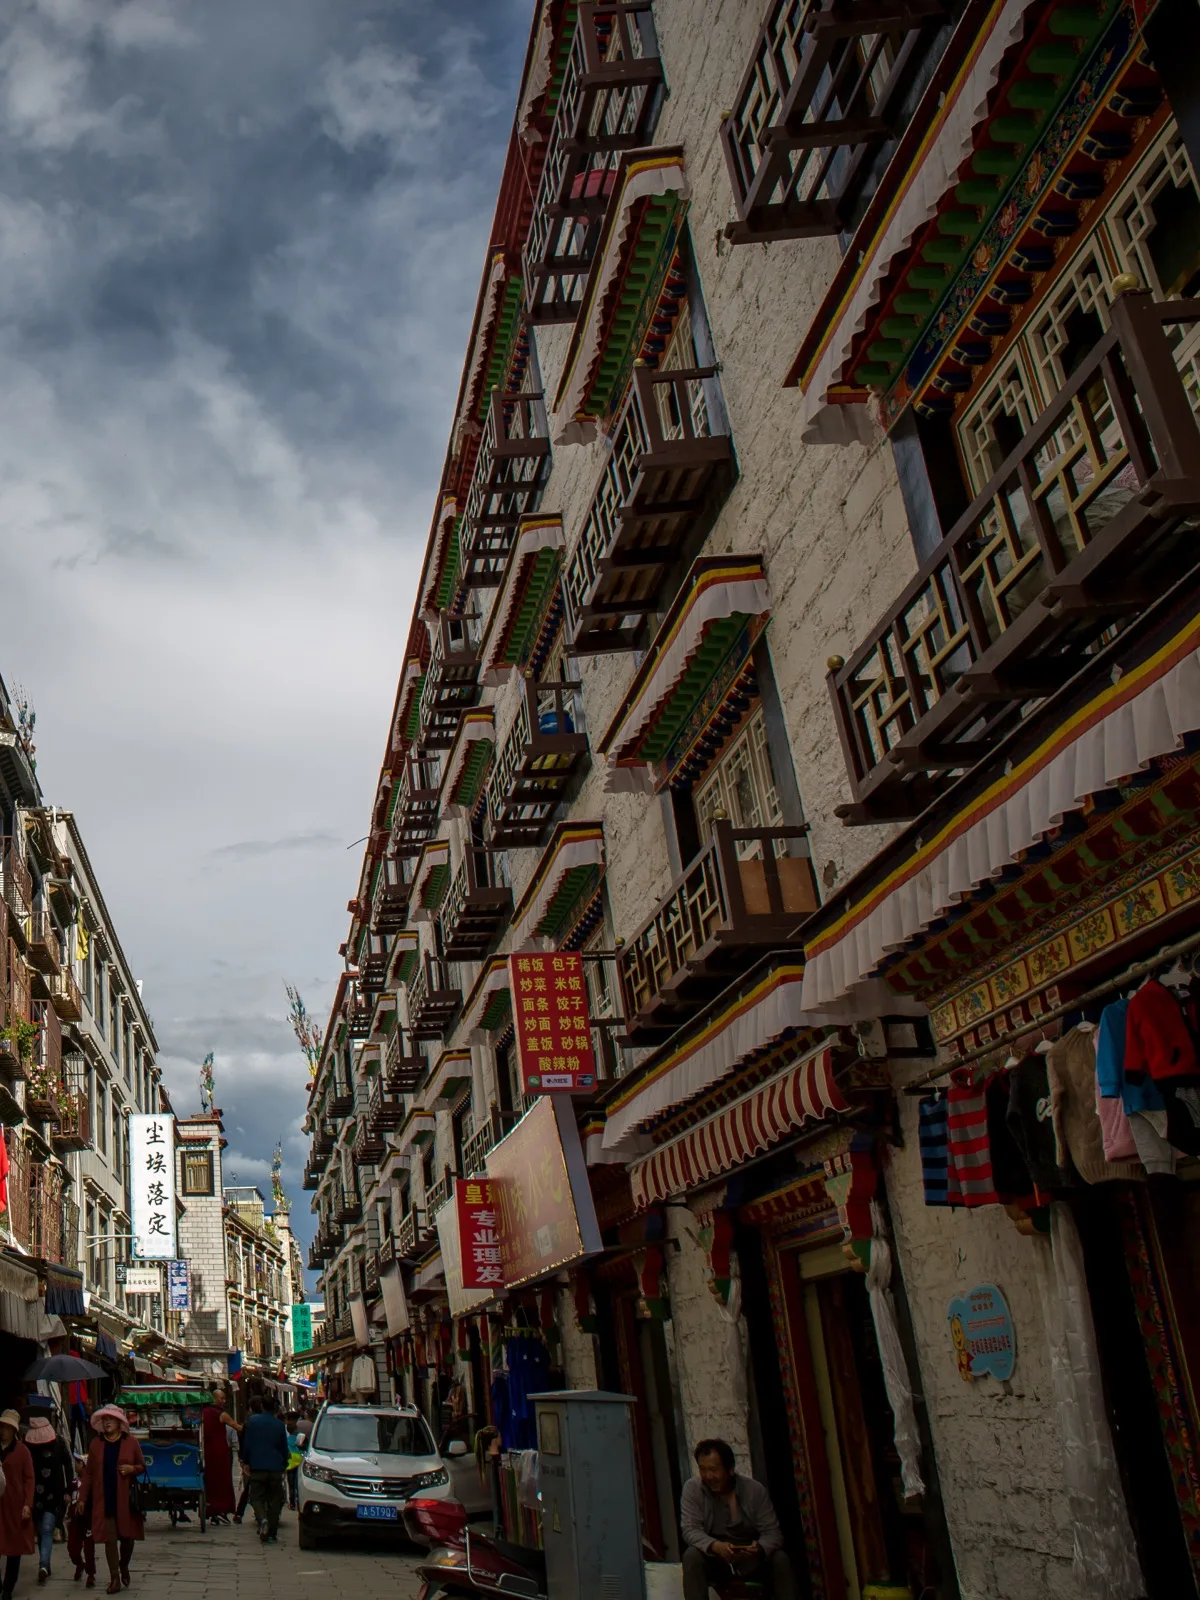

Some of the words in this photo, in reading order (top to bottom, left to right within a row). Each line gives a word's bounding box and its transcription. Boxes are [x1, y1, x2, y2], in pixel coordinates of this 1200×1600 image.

[518, 958, 544, 972] 稀饭
[552, 956, 578, 971] 包子
[520, 977, 547, 992] 炒菜
[554, 976, 581, 990] 米饭
[522, 997, 549, 1011] 面条
[557, 996, 583, 1010] 饺子
[524, 1017, 551, 1031] 炒面
[559, 1016, 586, 1030] 炒饭
[527, 1037, 554, 1051] 盖饭
[561, 1036, 589, 1050] 砂锅
[538, 1056, 580, 1071] 酸辣粉
[145, 1121, 171, 1236] 尘埃落定
[497, 1145, 563, 1238] 川味小吃
[470, 1209, 504, 1284] 专业理发
